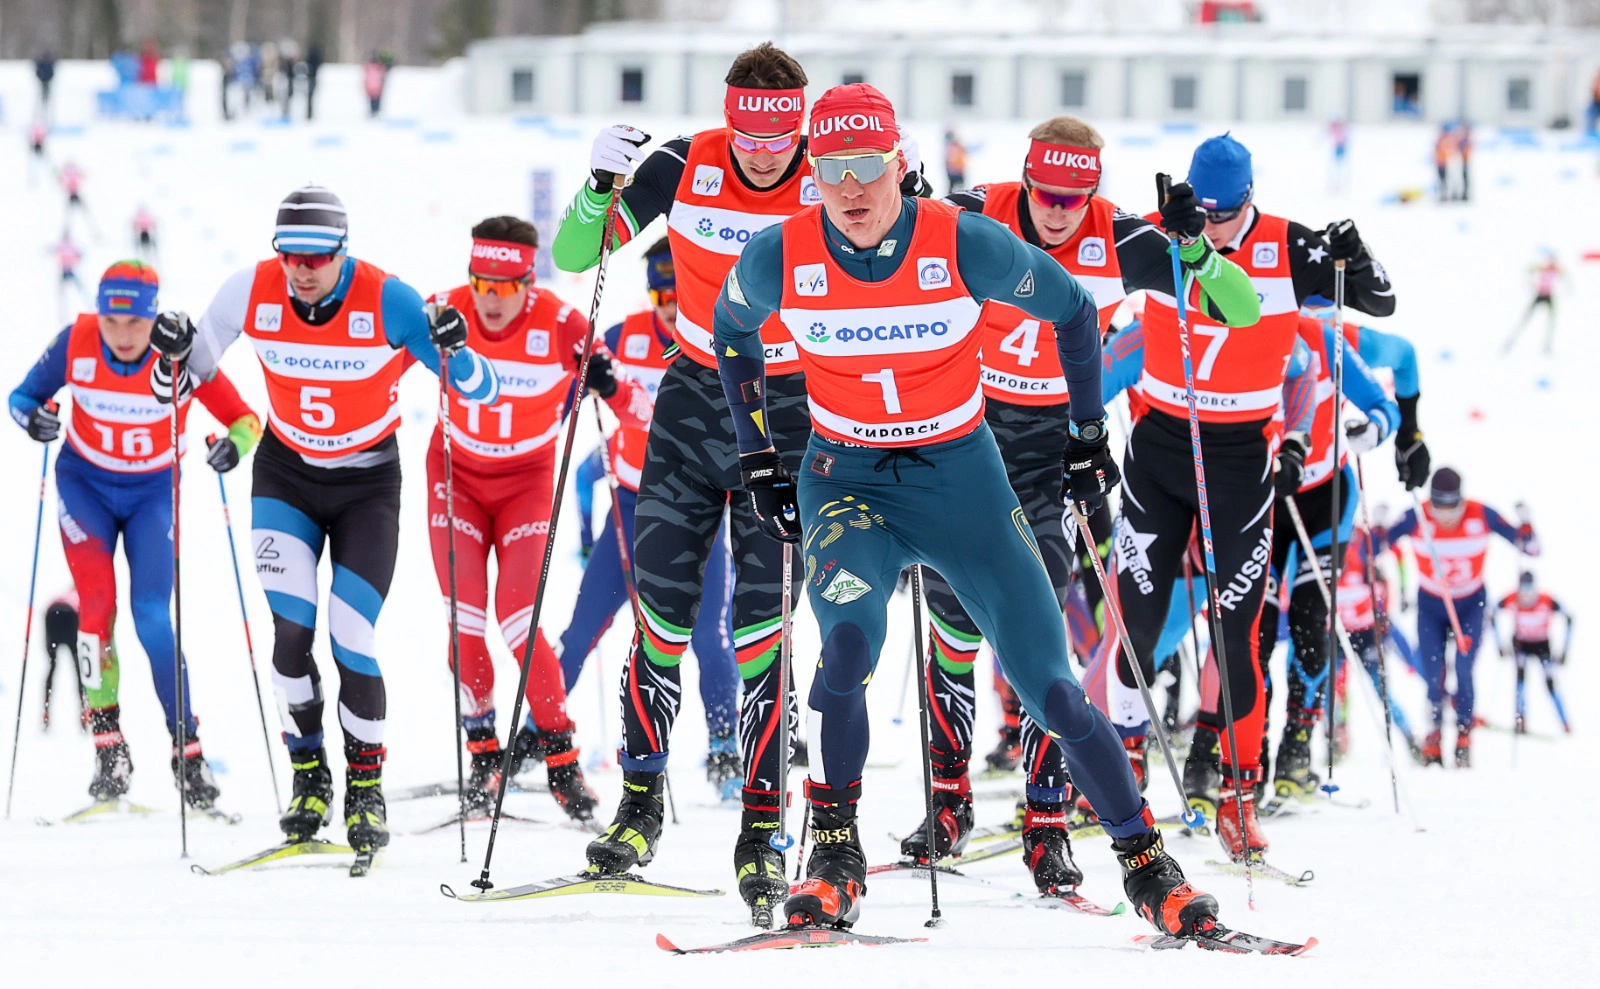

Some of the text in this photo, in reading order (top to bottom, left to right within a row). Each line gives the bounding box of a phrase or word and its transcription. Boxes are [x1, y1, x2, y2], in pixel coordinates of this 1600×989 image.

[738, 95, 801, 112] LUKOIL
[813, 113, 884, 139] LUKOIL
[1043, 149, 1098, 170] LUKOIL
[472, 243, 523, 263] LUKOIL
[835, 321, 949, 342] ФОСАГРО
[999, 318, 1041, 367] 4
[1192, 323, 1230, 381] 7
[285, 356, 365, 371] ФОСАГРО
[499, 375, 538, 388] АГРО
[861, 368, 902, 415] 1
[299, 385, 336, 429] 5
[457, 397, 514, 439] 11
[92, 421, 154, 457] 16
[853, 421, 940, 438] КИРОВСК
[750, 468, 774, 479] SWIX
[1069, 459, 1092, 471] SWIX
[1219, 526, 1274, 611] RUSSIA
[833, 579, 857, 591] УЛК
[623, 780, 649, 793] CHER
[751, 821, 780, 829] FISC
[592, 881, 627, 893] FISCHER
